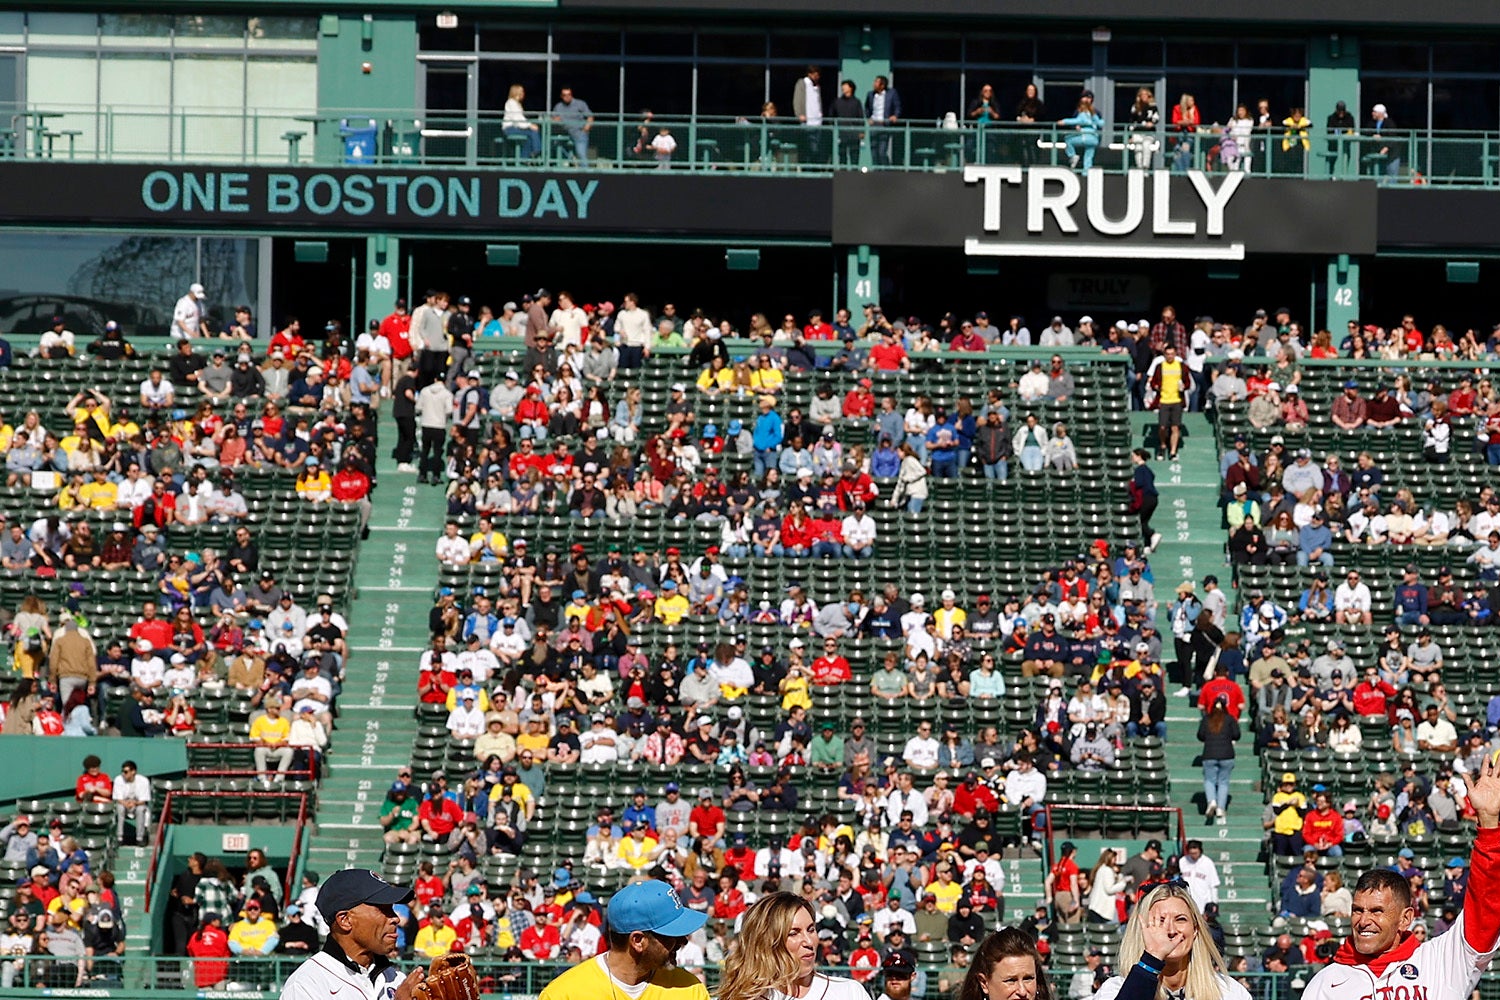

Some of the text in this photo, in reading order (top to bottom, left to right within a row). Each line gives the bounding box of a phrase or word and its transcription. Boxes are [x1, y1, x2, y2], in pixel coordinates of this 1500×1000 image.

[142, 170, 598, 219] ONE BOSTON DAY
[964, 165, 1244, 236] TRULY
[373, 271, 391, 290] 39
[855, 281, 871, 298] 41
[1068, 278, 1130, 294] TRULY
[1335, 288, 1352, 306] 42
[227, 837, 244, 848] EXIT
